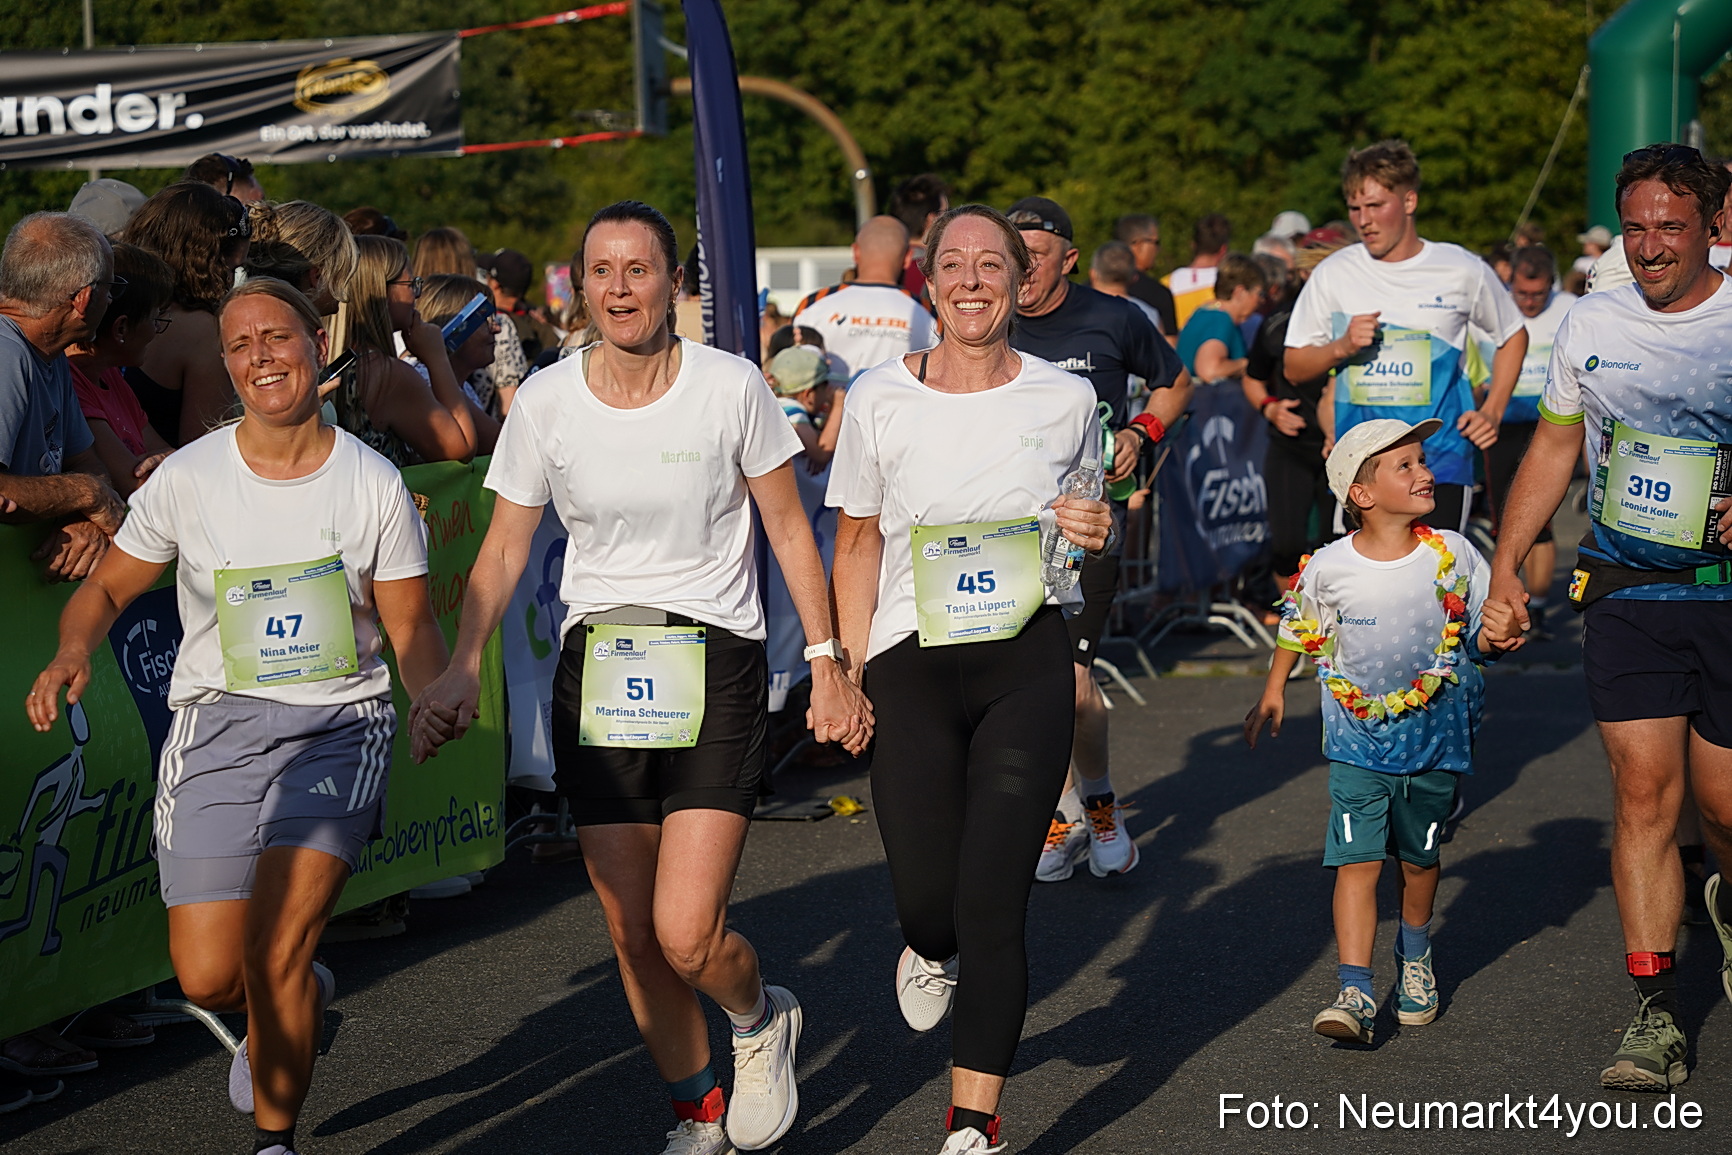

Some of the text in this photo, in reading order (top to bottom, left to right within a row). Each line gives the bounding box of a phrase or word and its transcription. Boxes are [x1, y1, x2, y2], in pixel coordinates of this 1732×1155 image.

[851, 316, 912, 329] KLEBL
[1363, 361, 1414, 376] 2440
[1601, 360, 1641, 371] Bionorica
[1019, 435, 1044, 450] Tanja
[661, 450, 701, 464] Martina
[1628, 450, 1660, 462] Firmenlauf
[1628, 474, 1672, 502] 319
[1620, 498, 1678, 520] Leonid Koller
[320, 528, 341, 542] Nina
[1706, 512, 1718, 544] HILTL
[944, 544, 981, 556] Firmenlauf
[956, 570, 996, 594] 45
[248, 587, 288, 600] Firmenlauf
[945, 599, 1016, 614] Tanja Lippert
[266, 614, 302, 639] 47
[1344, 616, 1376, 626] Bionorica
[260, 642, 320, 658] Nina Meier
[626, 677, 654, 700] 51
[596, 706, 690, 720] Martina Scheuerer
